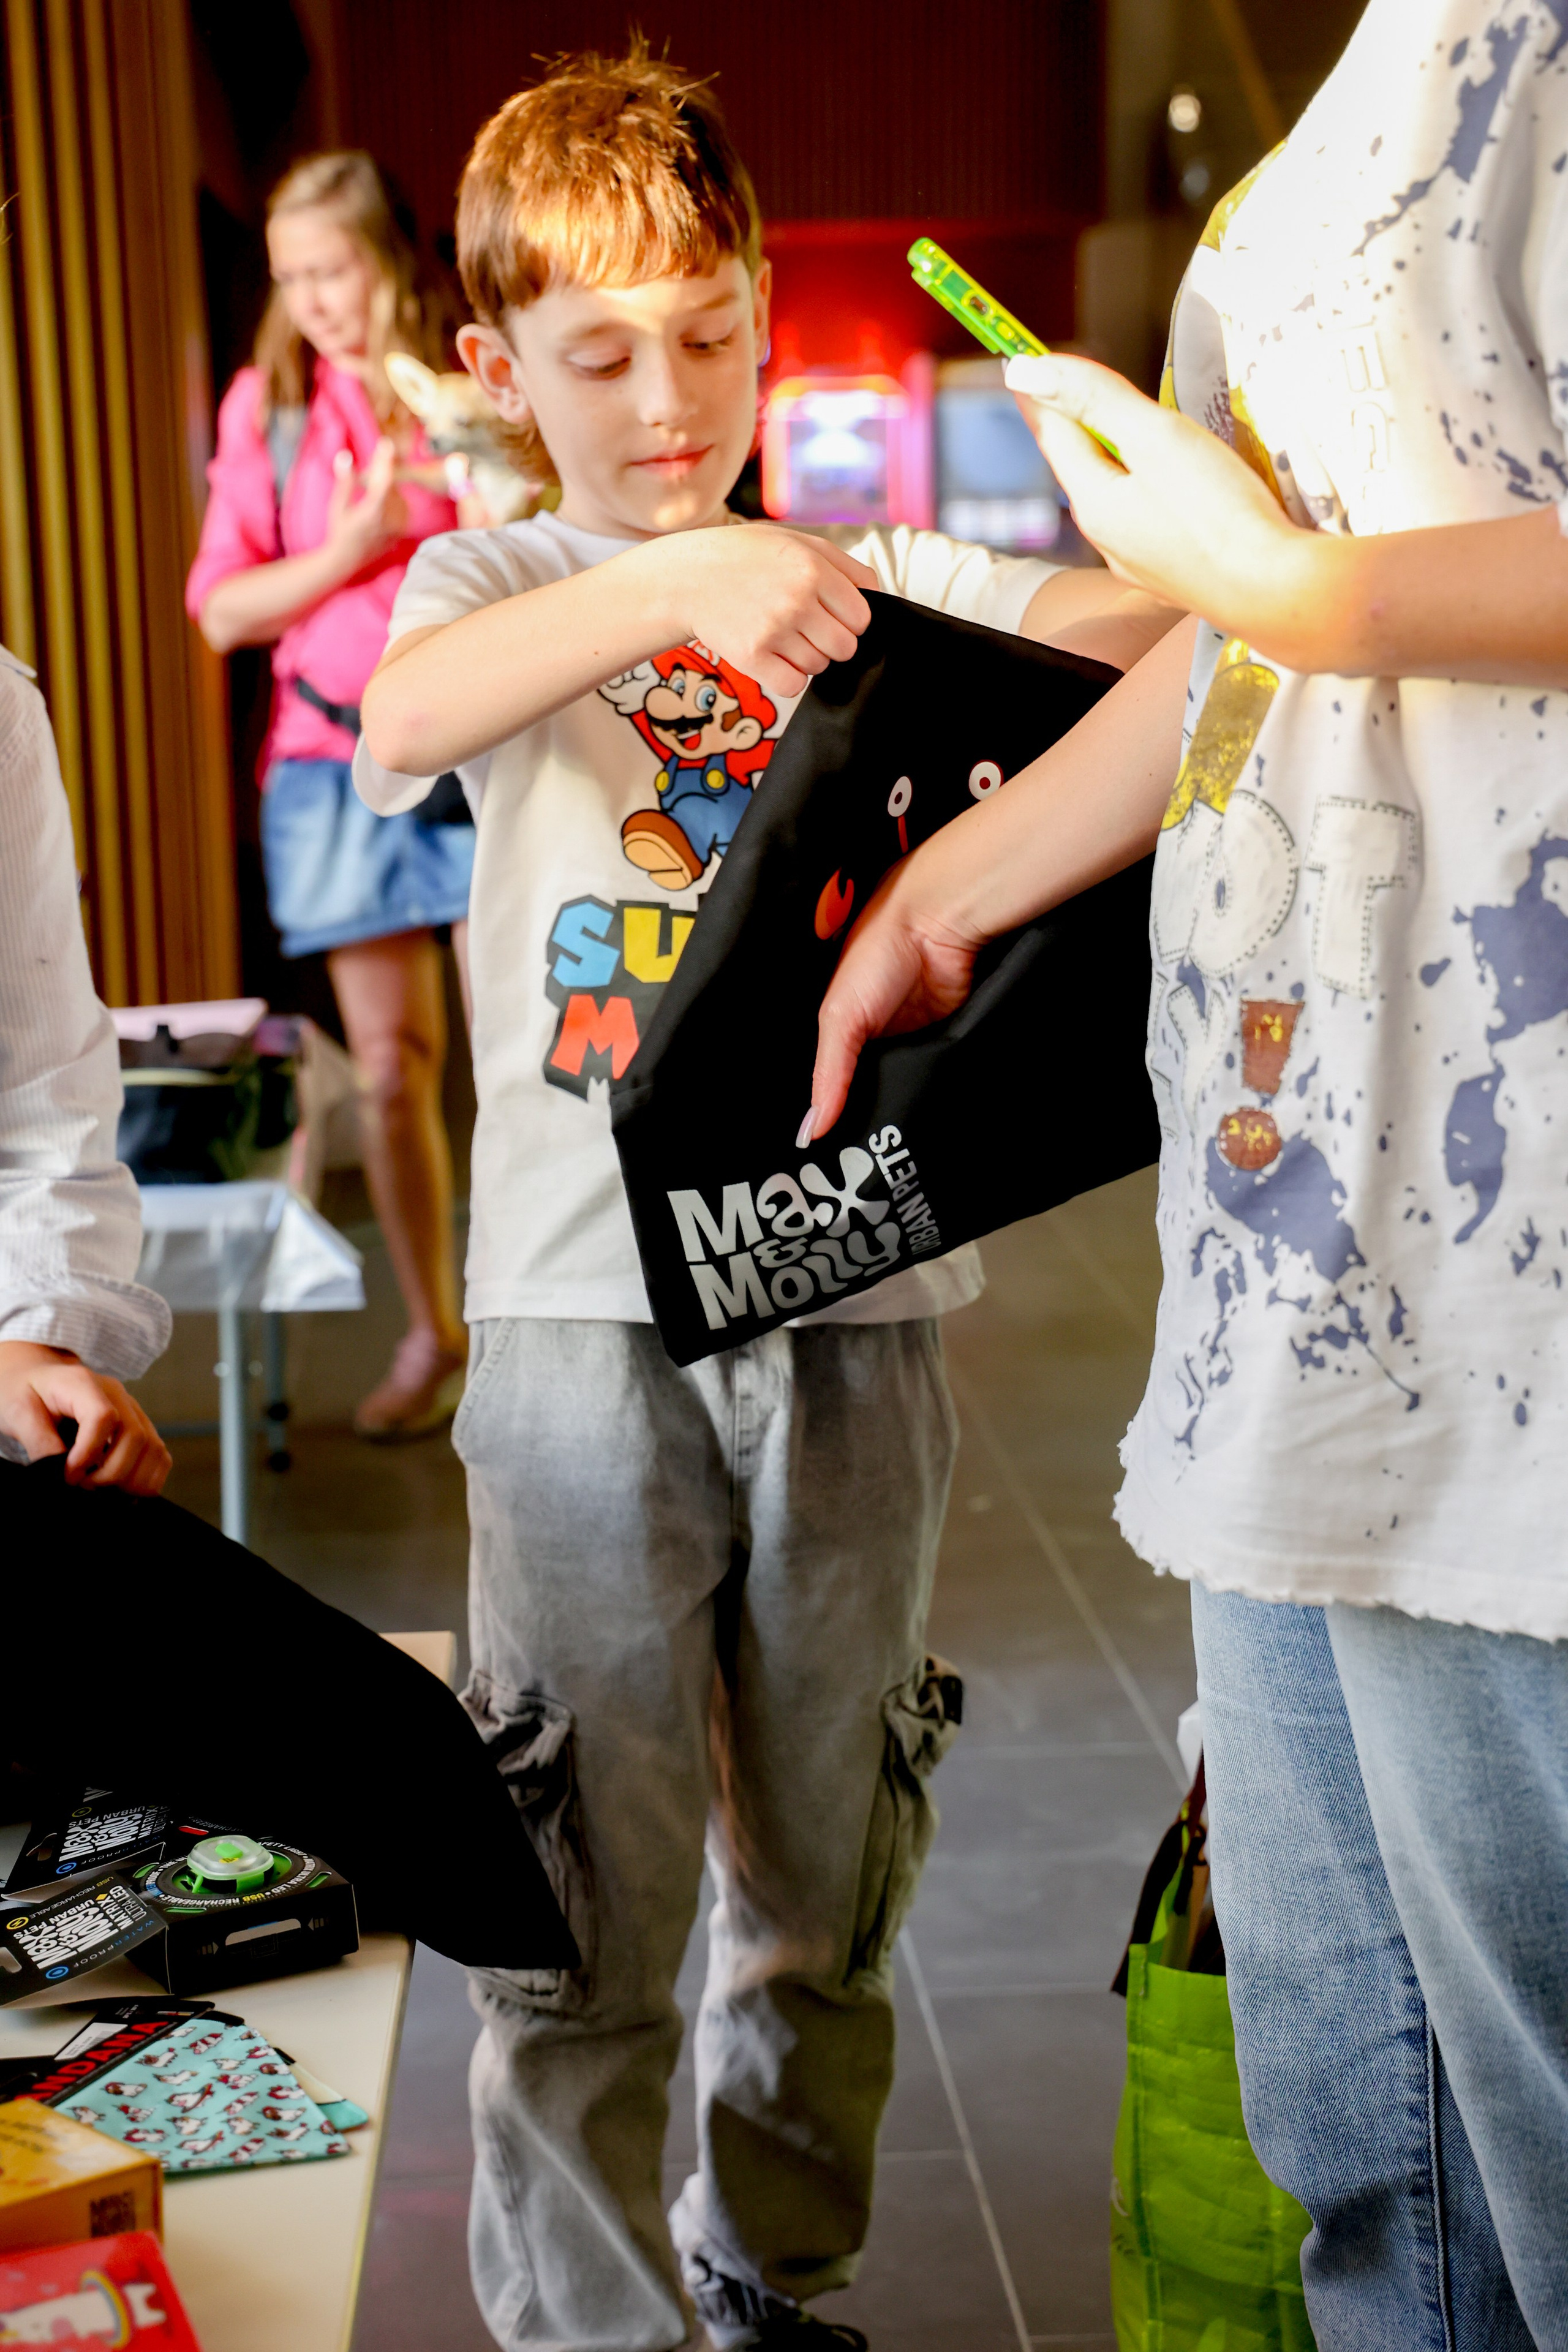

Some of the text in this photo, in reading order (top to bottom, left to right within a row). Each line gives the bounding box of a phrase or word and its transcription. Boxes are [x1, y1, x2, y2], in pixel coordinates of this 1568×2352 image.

[551, 901, 696, 987] SU
[666, 1146, 890, 1262] Max
[869, 1125, 941, 1256] URBAN PETS
[753, 1237, 808, 1268] &
[689, 1221, 901, 1330] Molly
[68, 1816, 100, 1828] PETS
[13, 1899, 95, 1940] URBAN PETS
[29, 1876, 115, 1919] USB RECHARGEABLE
[98, 1894, 134, 1930] MATRIX
[164, 1894, 240, 1907] RECHARGEABLE
[242, 1893, 265, 1902] USB
[18, 1924, 78, 1970] Max
[73, 1919, 155, 1968] WATERPROOF
[13, 2020, 170, 2100] ANDANA
